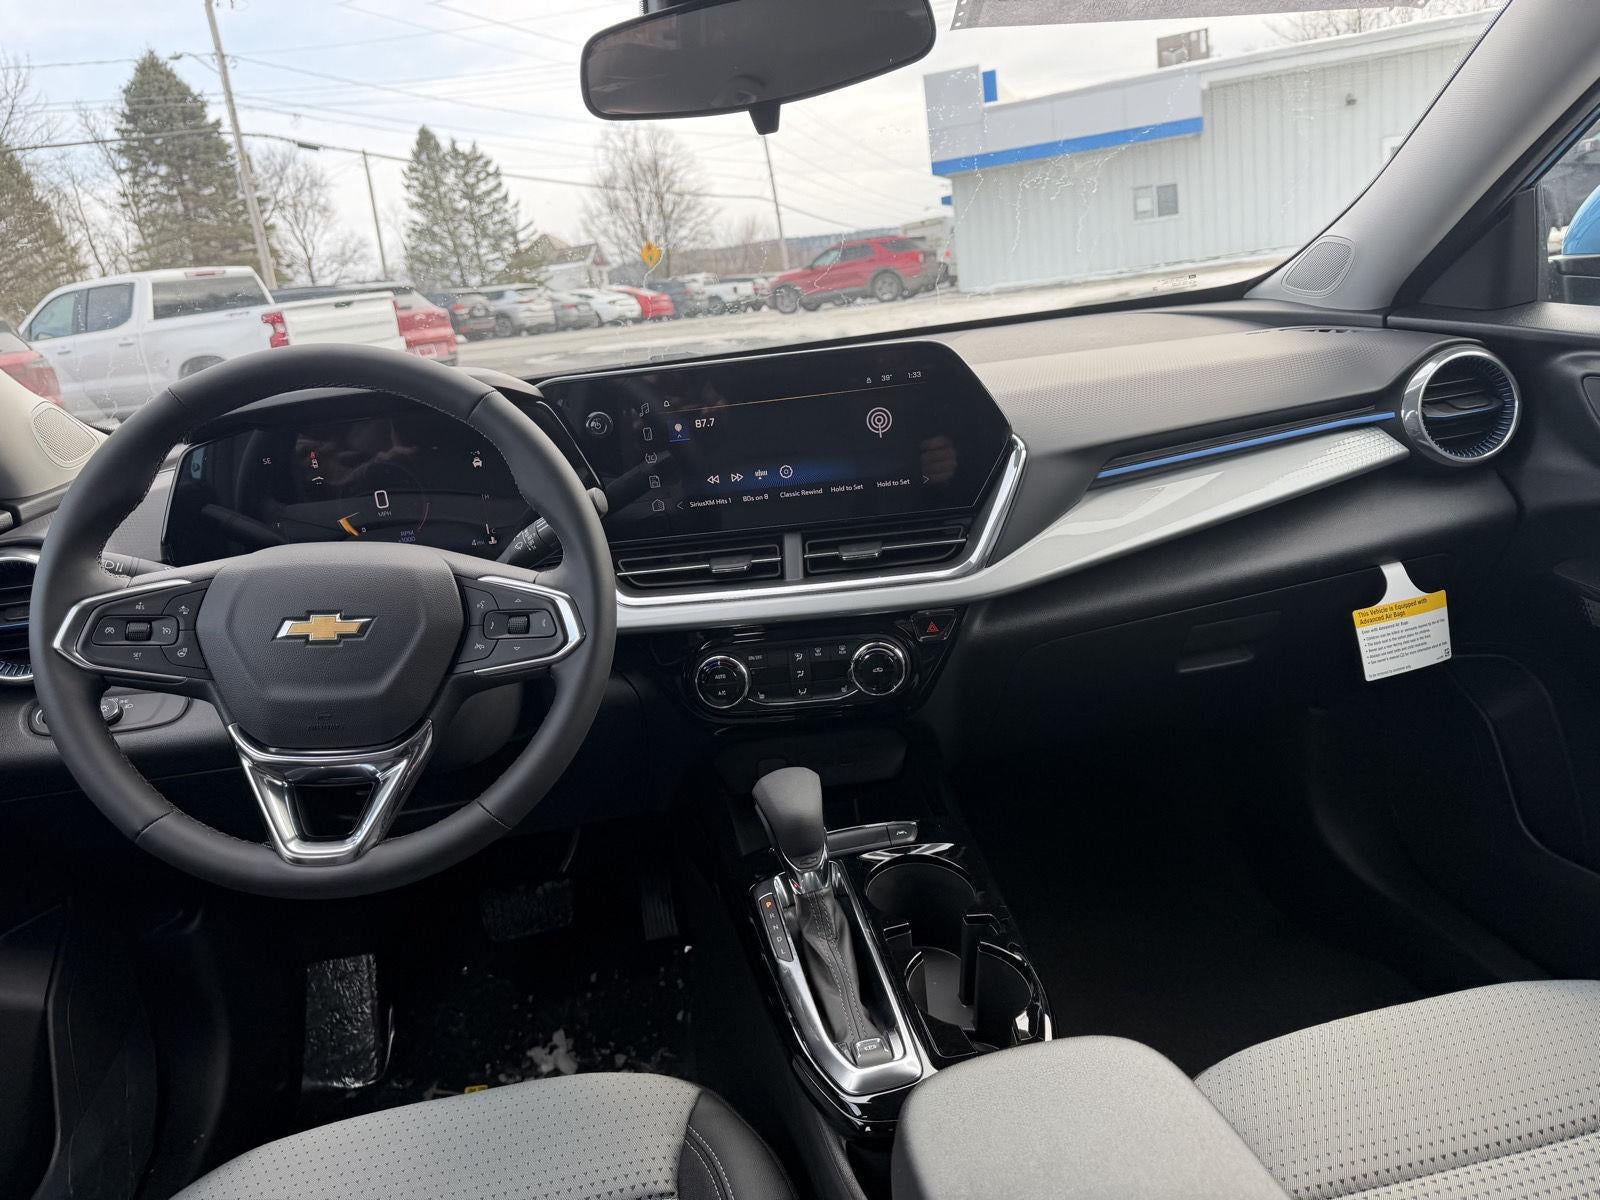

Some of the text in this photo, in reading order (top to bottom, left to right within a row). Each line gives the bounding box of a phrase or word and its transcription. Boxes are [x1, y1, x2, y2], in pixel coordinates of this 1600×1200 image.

[907, 371, 922, 379] 1:33
[695, 417, 715, 428] 87.7
[877, 480, 892, 488] Hold
[899, 478, 911, 486] Set
[780, 487, 823, 498] Classic Rewind
[830, 485, 845, 493] Hold
[374, 490, 389, 509] 0
[689, 499, 715, 508] SiriusXM
[1358, 611, 1370, 619] This
[1370, 607, 1389, 616] Vehicle
[1394, 601, 1417, 610] Equipped
[1360, 615, 1385, 625] Advanced
[1385, 613, 1393, 621] Air
